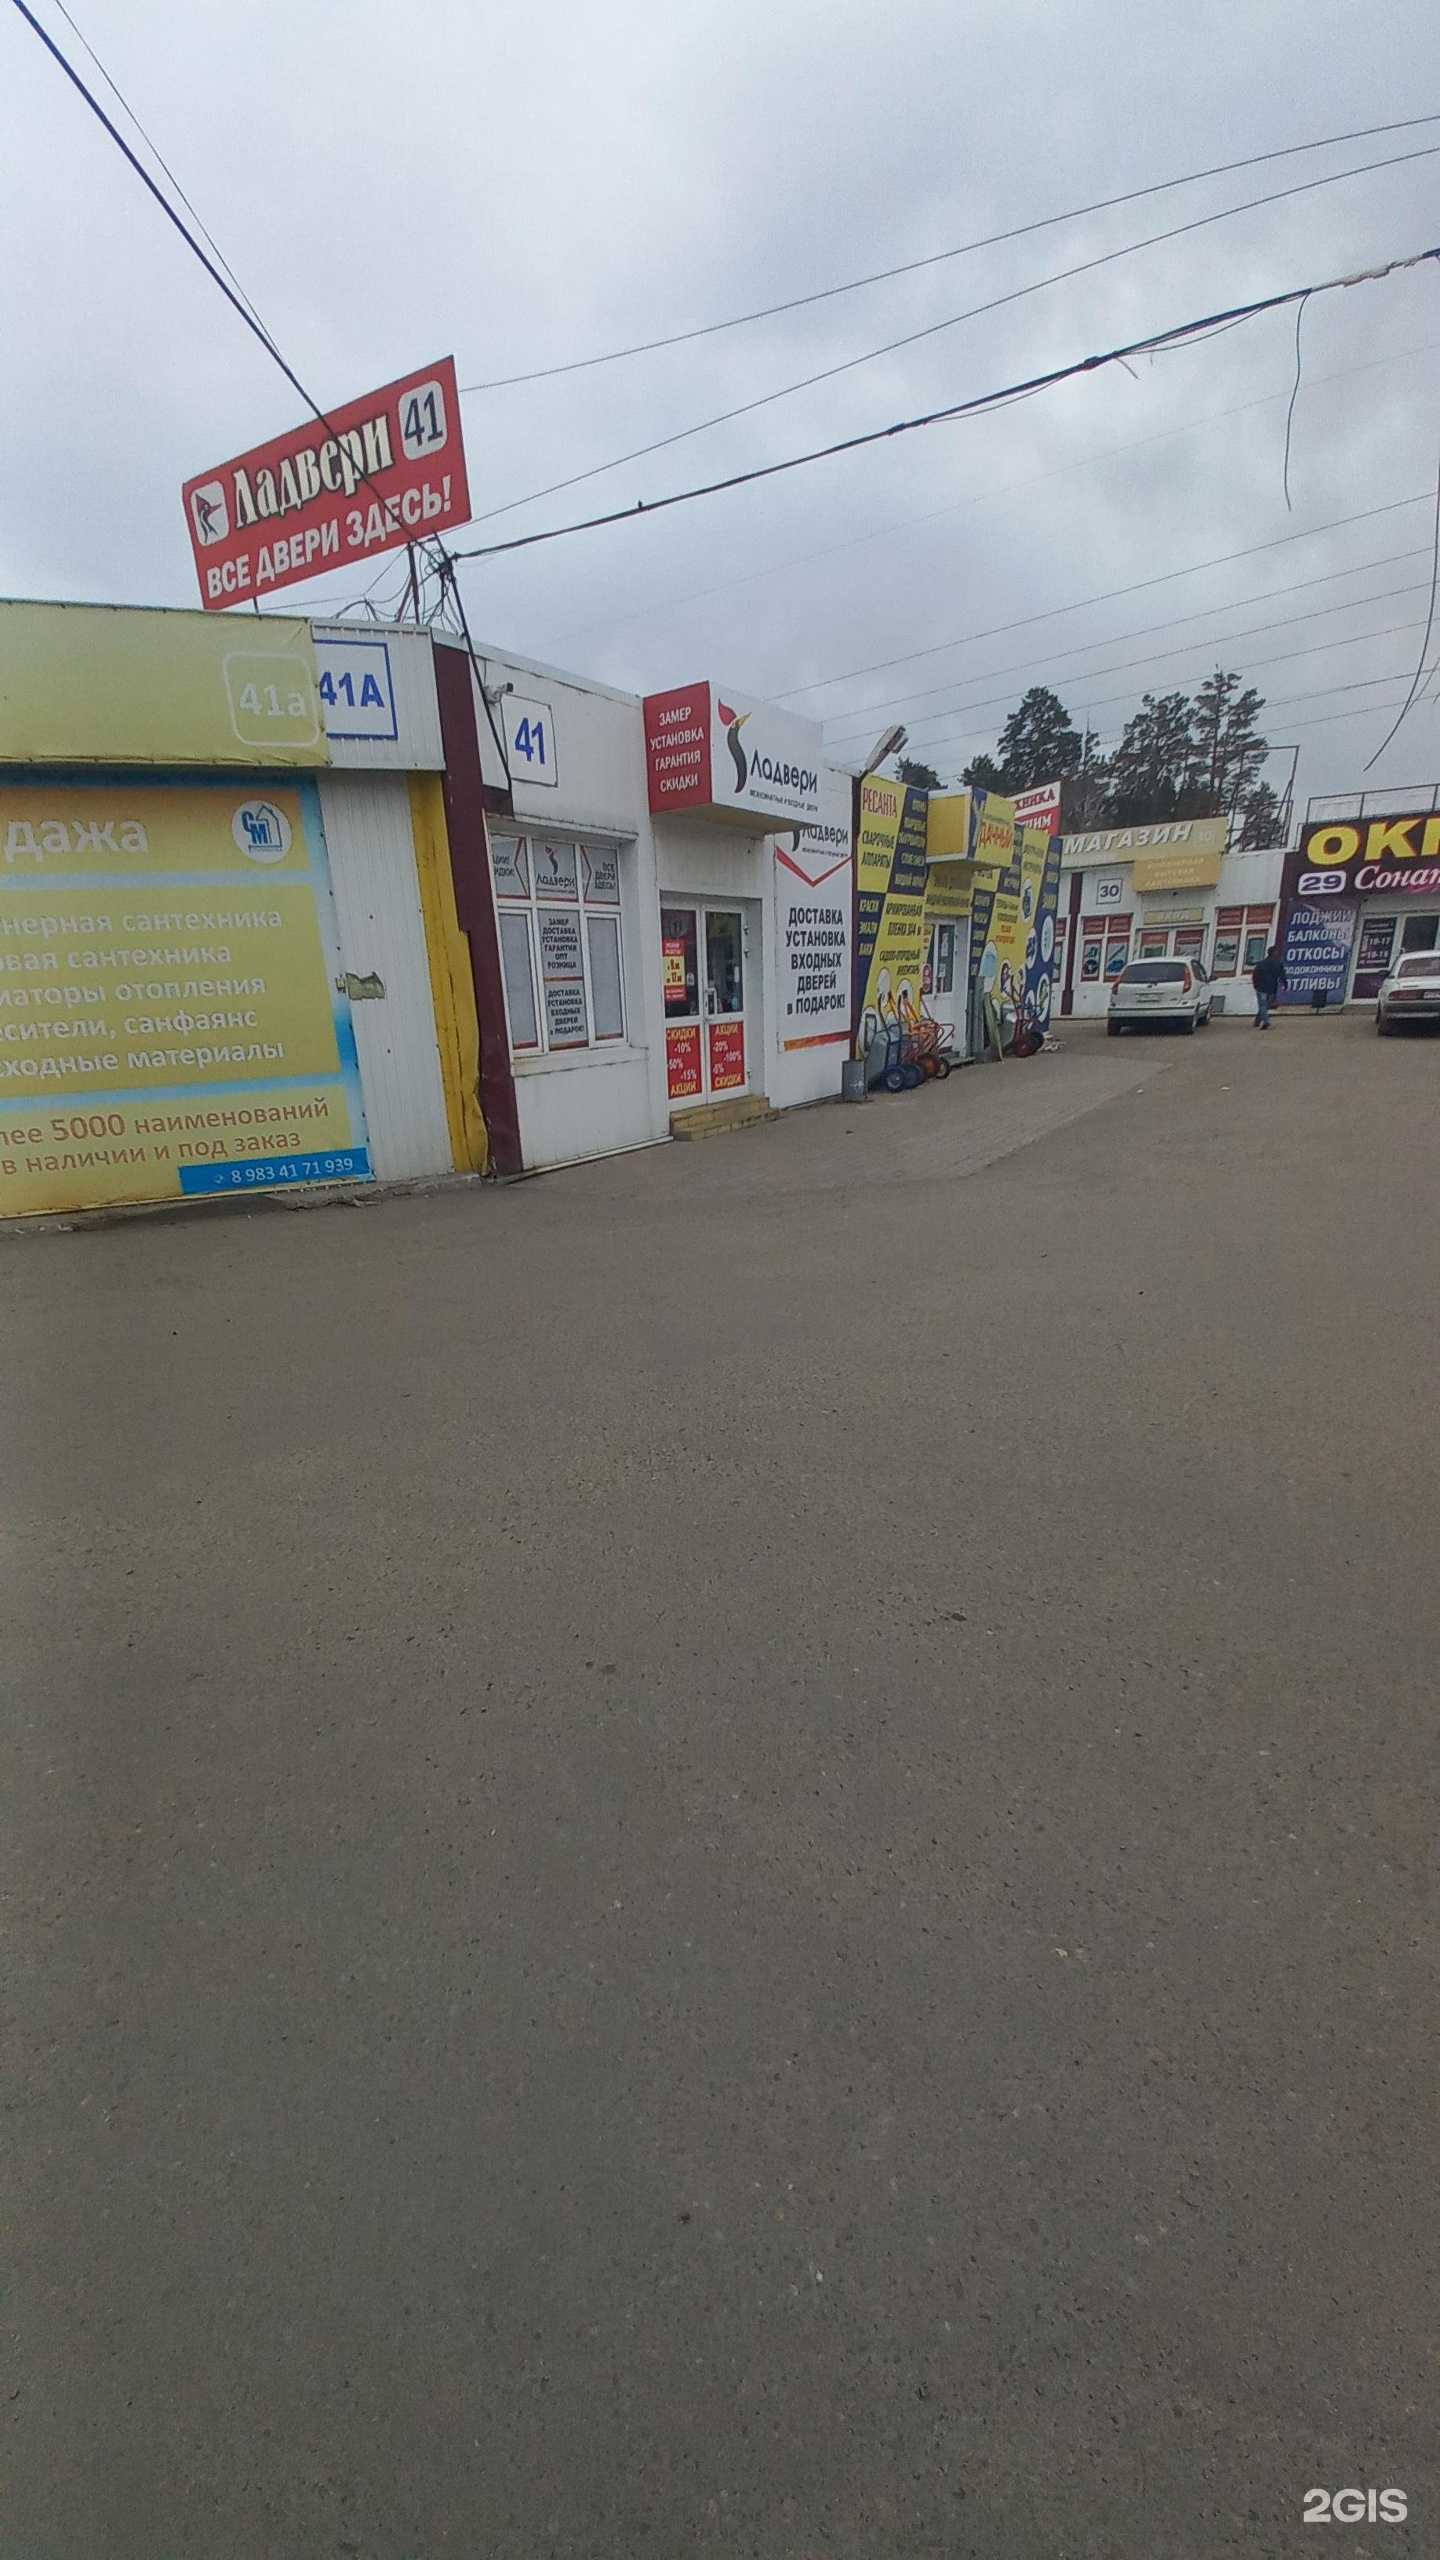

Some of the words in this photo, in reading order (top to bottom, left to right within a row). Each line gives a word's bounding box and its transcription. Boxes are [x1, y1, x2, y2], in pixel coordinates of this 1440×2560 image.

[403, 390, 443, 448] 41
[232, 415, 395, 528] Ладвери
[206, 554, 251, 598] ВСЕ
[255, 518, 340, 586] ДВЕРИ
[346, 474, 452, 547] ЗДЕСЬ!
[239, 683, 308, 718] 41а
[319, 672, 385, 708] 41А
[659, 706, 692, 726] ЗАМЕР
[514, 717, 545, 764] 41
[650, 727, 704, 750] УСТАНОВКА
[655, 750, 701, 771] ГАРАНТИЯ
[660, 773, 698, 793] СКИДКИ
[863, 787, 897, 818] РЕСАНТА
[3, 819, 150, 863] дажа
[1063, 823, 1193, 855] МАГАЗИН
[1100, 884, 1119, 897] 30
[1301, 874, 1341, 891] 29
[122, 910, 283, 933] сантехника
[788, 907, 843, 927] ДОСТАВКА
[1291, 910, 1351, 925] ЛОДЖИИ
[785, 930, 846, 948] УСТАНОВКА
[0, 951, 58, 972] вая
[68, 944, 232, 969] сантехника
[791, 952, 842, 972] ВХОДНЫХ
[1287, 946, 1344, 961] ОТКОСЫ
[115, 976, 266, 1003] отопления
[797, 970, 836, 994] ДВЕРЕЙ
[796, 993, 845, 1015] ПОДАРОК!
[0, 1017, 116, 1042] сители,
[124, 1008, 257, 1036] санфаянс
[127, 1041, 285, 1070] материалы
[51, 1112, 126, 1143] 5000
[135, 1097, 330, 1136] наименований
[2, 1159, 17, 1175] в
[26, 1146, 145, 1175] наличии
[154, 1143, 170, 1160] и
[178, 1139, 228, 1159] под
[235, 1131, 301, 1152] заказ
[231, 1170, 242, 1183] 8
[245, 1166, 275, 1182] 983
[278, 1164, 299, 1178] 41
[302, 1162, 321, 1175] 71
[324, 1158, 353, 1172] 939
